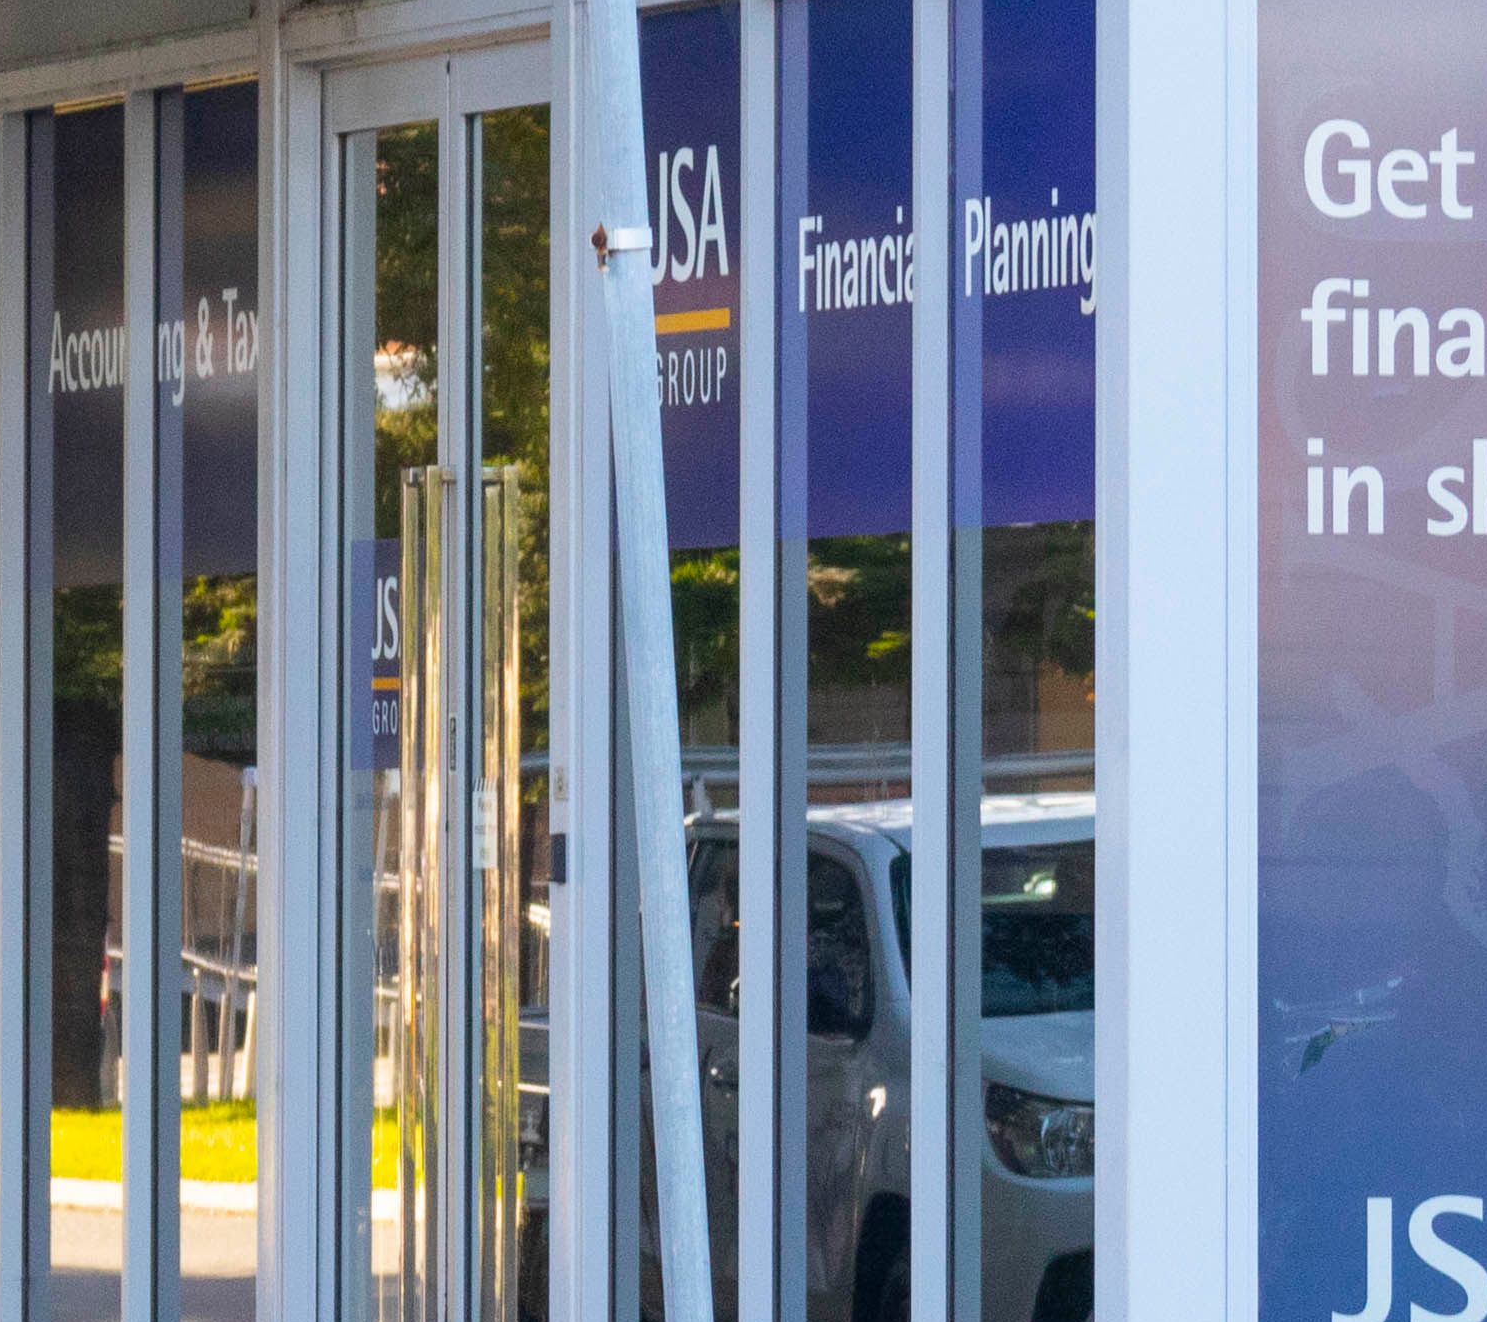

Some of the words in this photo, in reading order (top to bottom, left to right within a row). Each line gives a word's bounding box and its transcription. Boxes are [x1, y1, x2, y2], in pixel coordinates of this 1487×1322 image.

[652, 145, 729, 285] JSA
[1302, 119, 1476, 219] Get
[798, 206, 913, 312] Financia
[964, 188, 1096, 315] Planning
[48, 311, 185, 406] Accoung
[196, 296, 214, 378] &
[222, 287, 259, 374] Tax
[1307, 438, 1384, 536] in
[371, 576, 401, 660] JS
[371, 700, 399, 735] GRO
